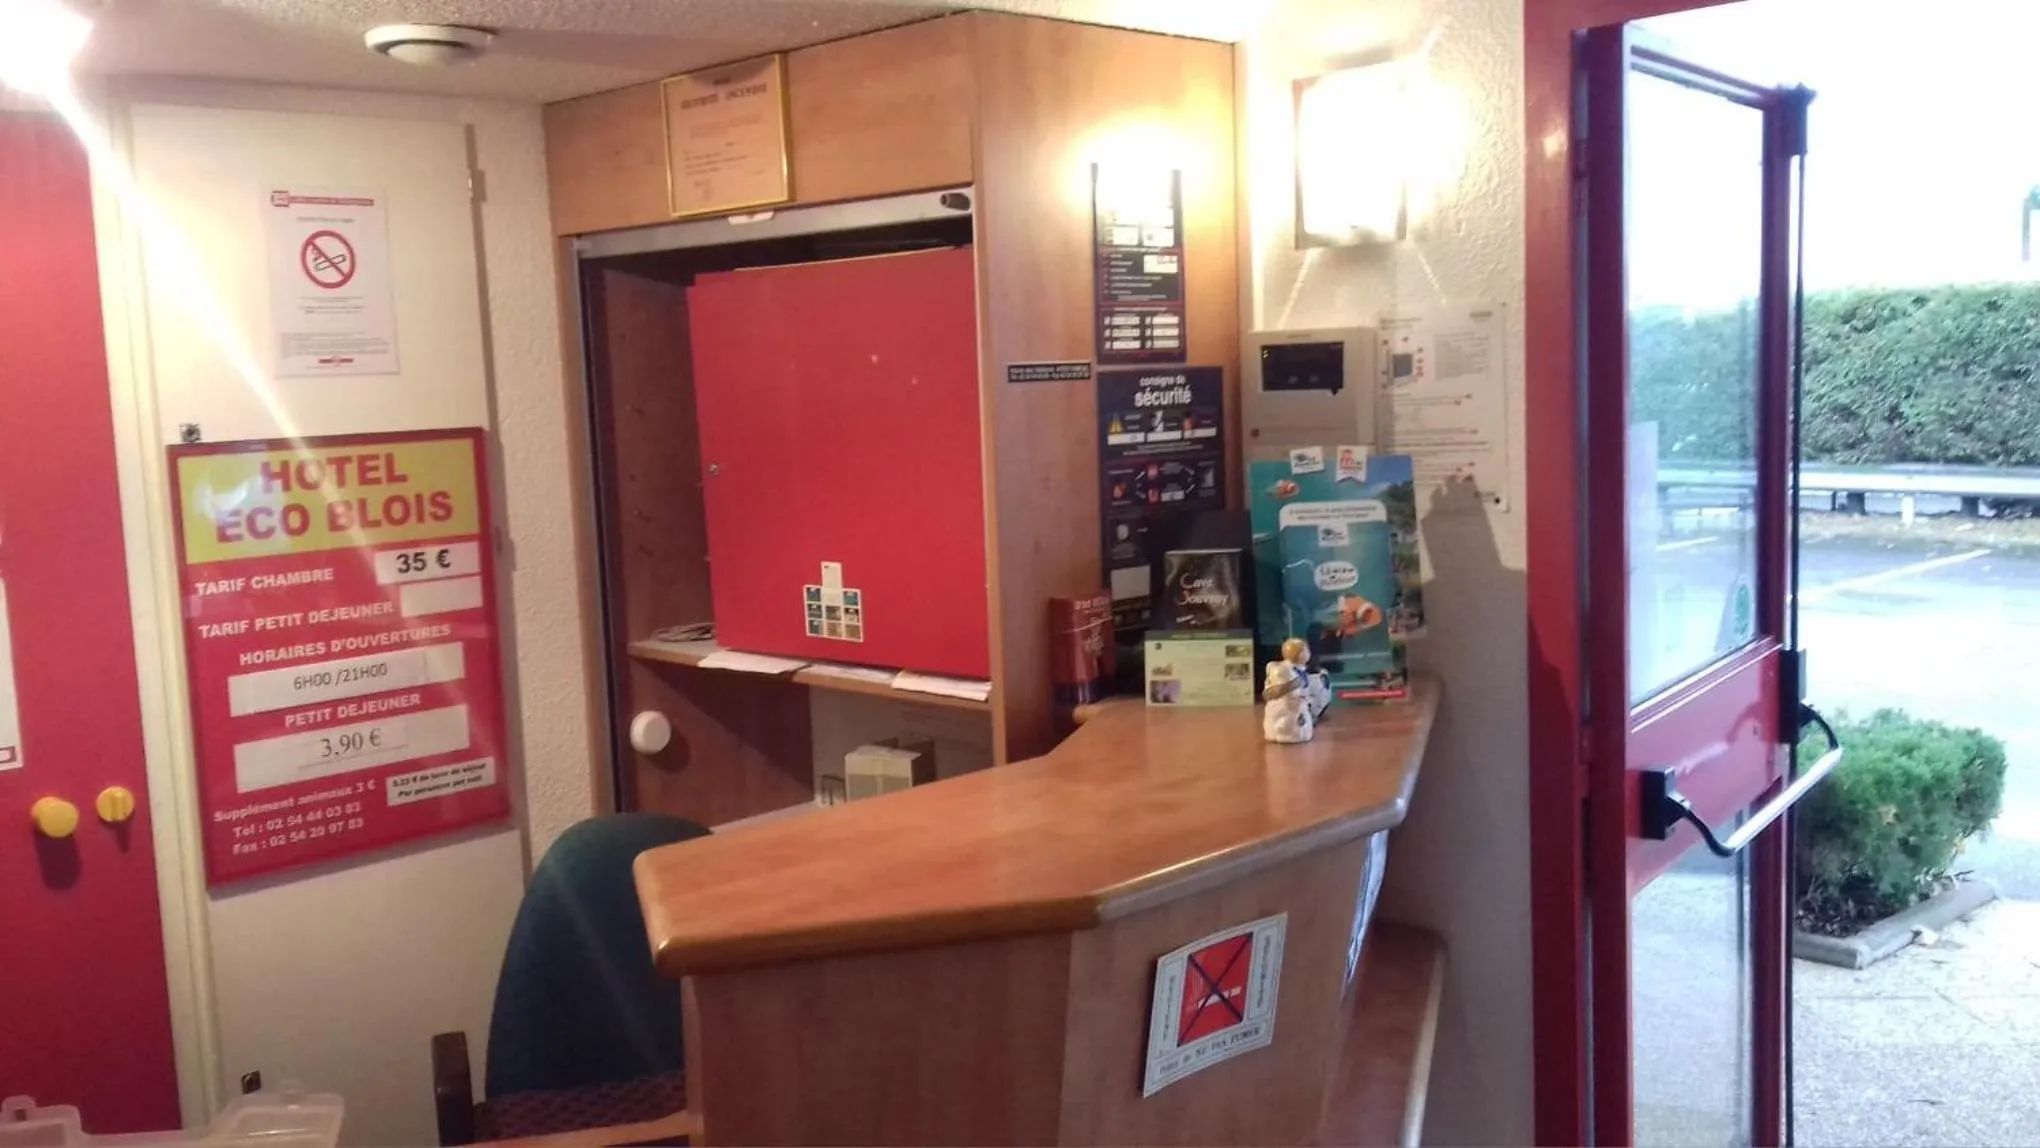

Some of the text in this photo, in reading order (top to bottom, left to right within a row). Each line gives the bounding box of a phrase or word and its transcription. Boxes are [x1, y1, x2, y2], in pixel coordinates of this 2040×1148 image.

[1134, 384, 1191, 408] sécurité
[260, 452, 408, 494] HOTEL
[215, 490, 454, 544] ECO BLOIS
[396, 548, 452, 574] 35 €
[195, 567, 334, 596] TARIF CHAMBRE
[198, 600, 394, 639] TARIF PETIT DEJEUNER
[239, 624, 452, 666] HORAIRES D'OUVERTURES
[293, 671, 332, 691] 6H00
[284, 693, 422, 729] PETIT DEJEUNER
[369, 727, 382, 748] €
[298, 785, 352, 805] animaux
[266, 818, 283, 831] 02
[233, 842, 257, 856] Fax
[269, 834, 286, 848] 02
